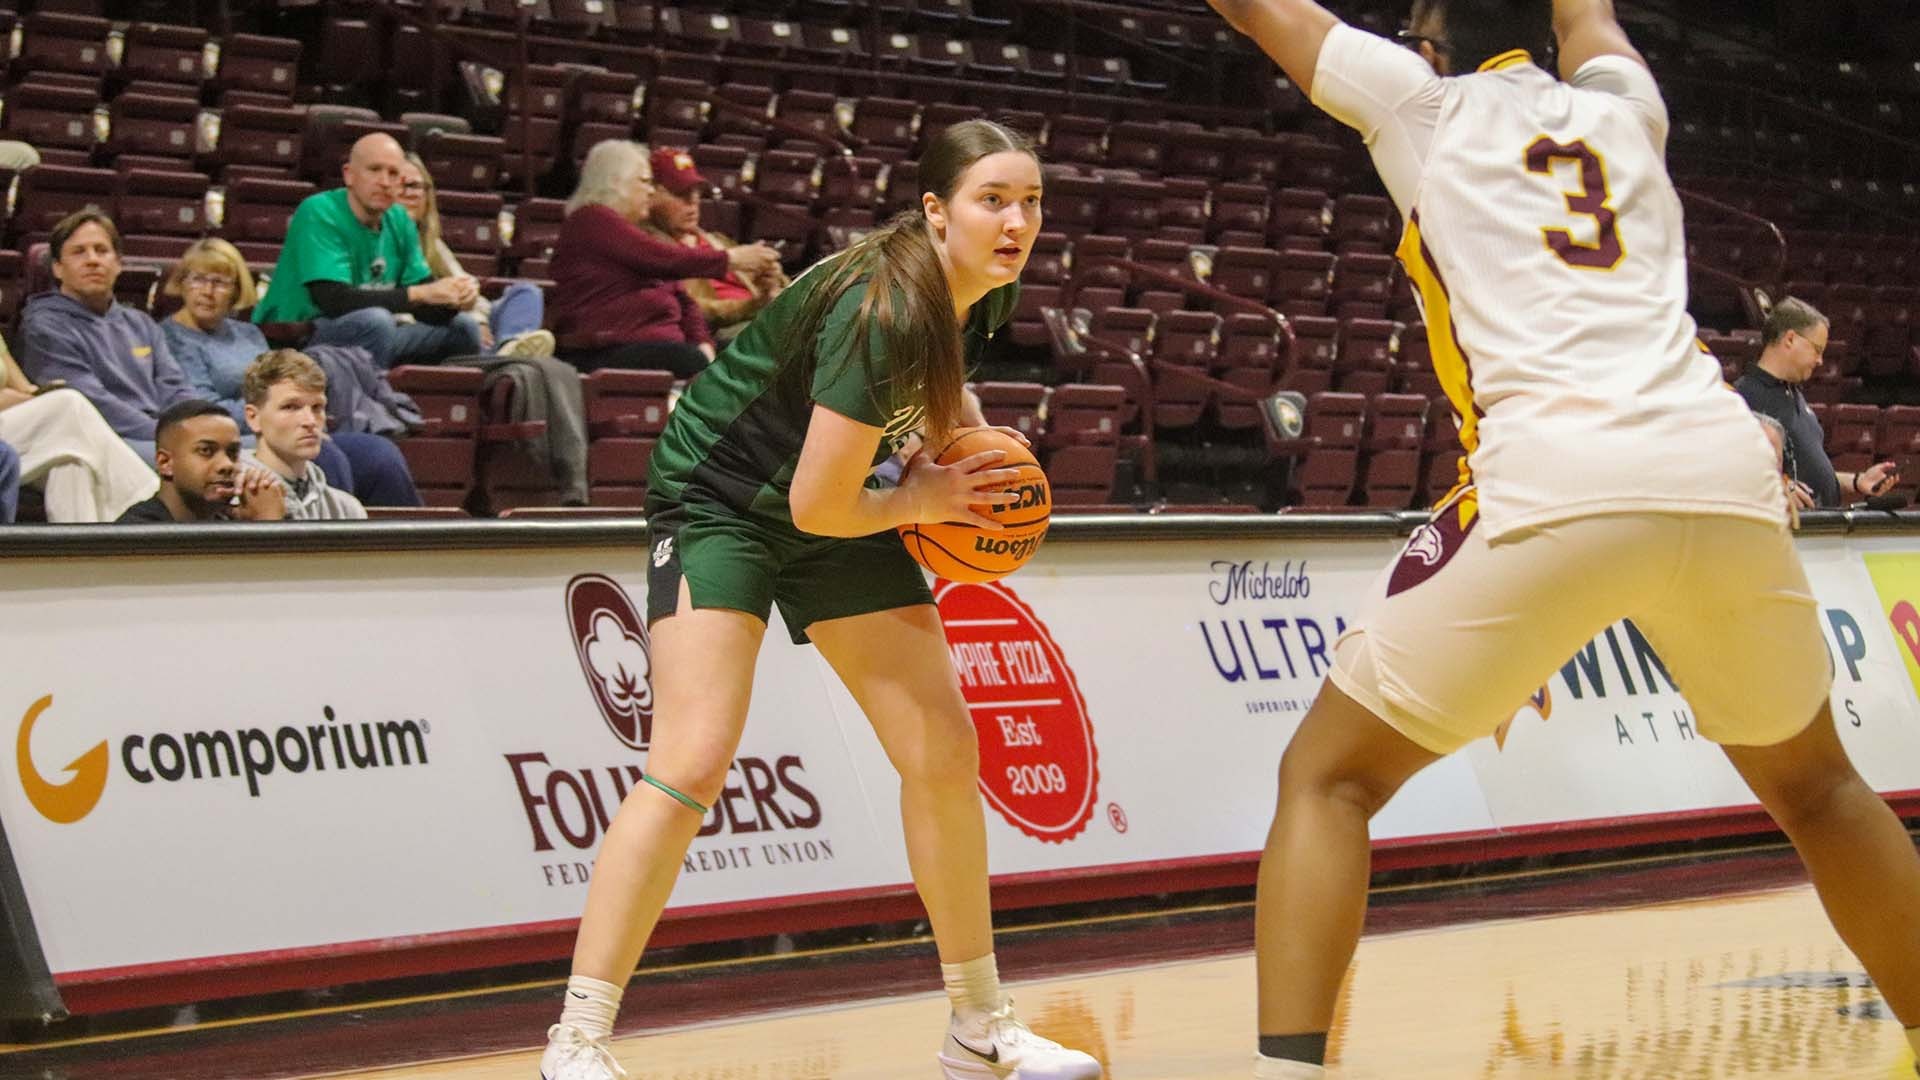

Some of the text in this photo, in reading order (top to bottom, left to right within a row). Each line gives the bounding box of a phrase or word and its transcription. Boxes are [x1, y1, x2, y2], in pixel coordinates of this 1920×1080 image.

[1522, 134, 1626, 272] 3
[1209, 560, 1310, 605] Michelob
[950, 640, 1056, 687] MPIRE PIZZA
[1199, 616, 1346, 682] ULTR
[996, 715, 1042, 747] Est
[504, 751, 822, 852] FOUERS
[1005, 763, 1067, 795] 2009
[684, 847, 751, 874] REDIT
[762, 840, 835, 865] UNION
